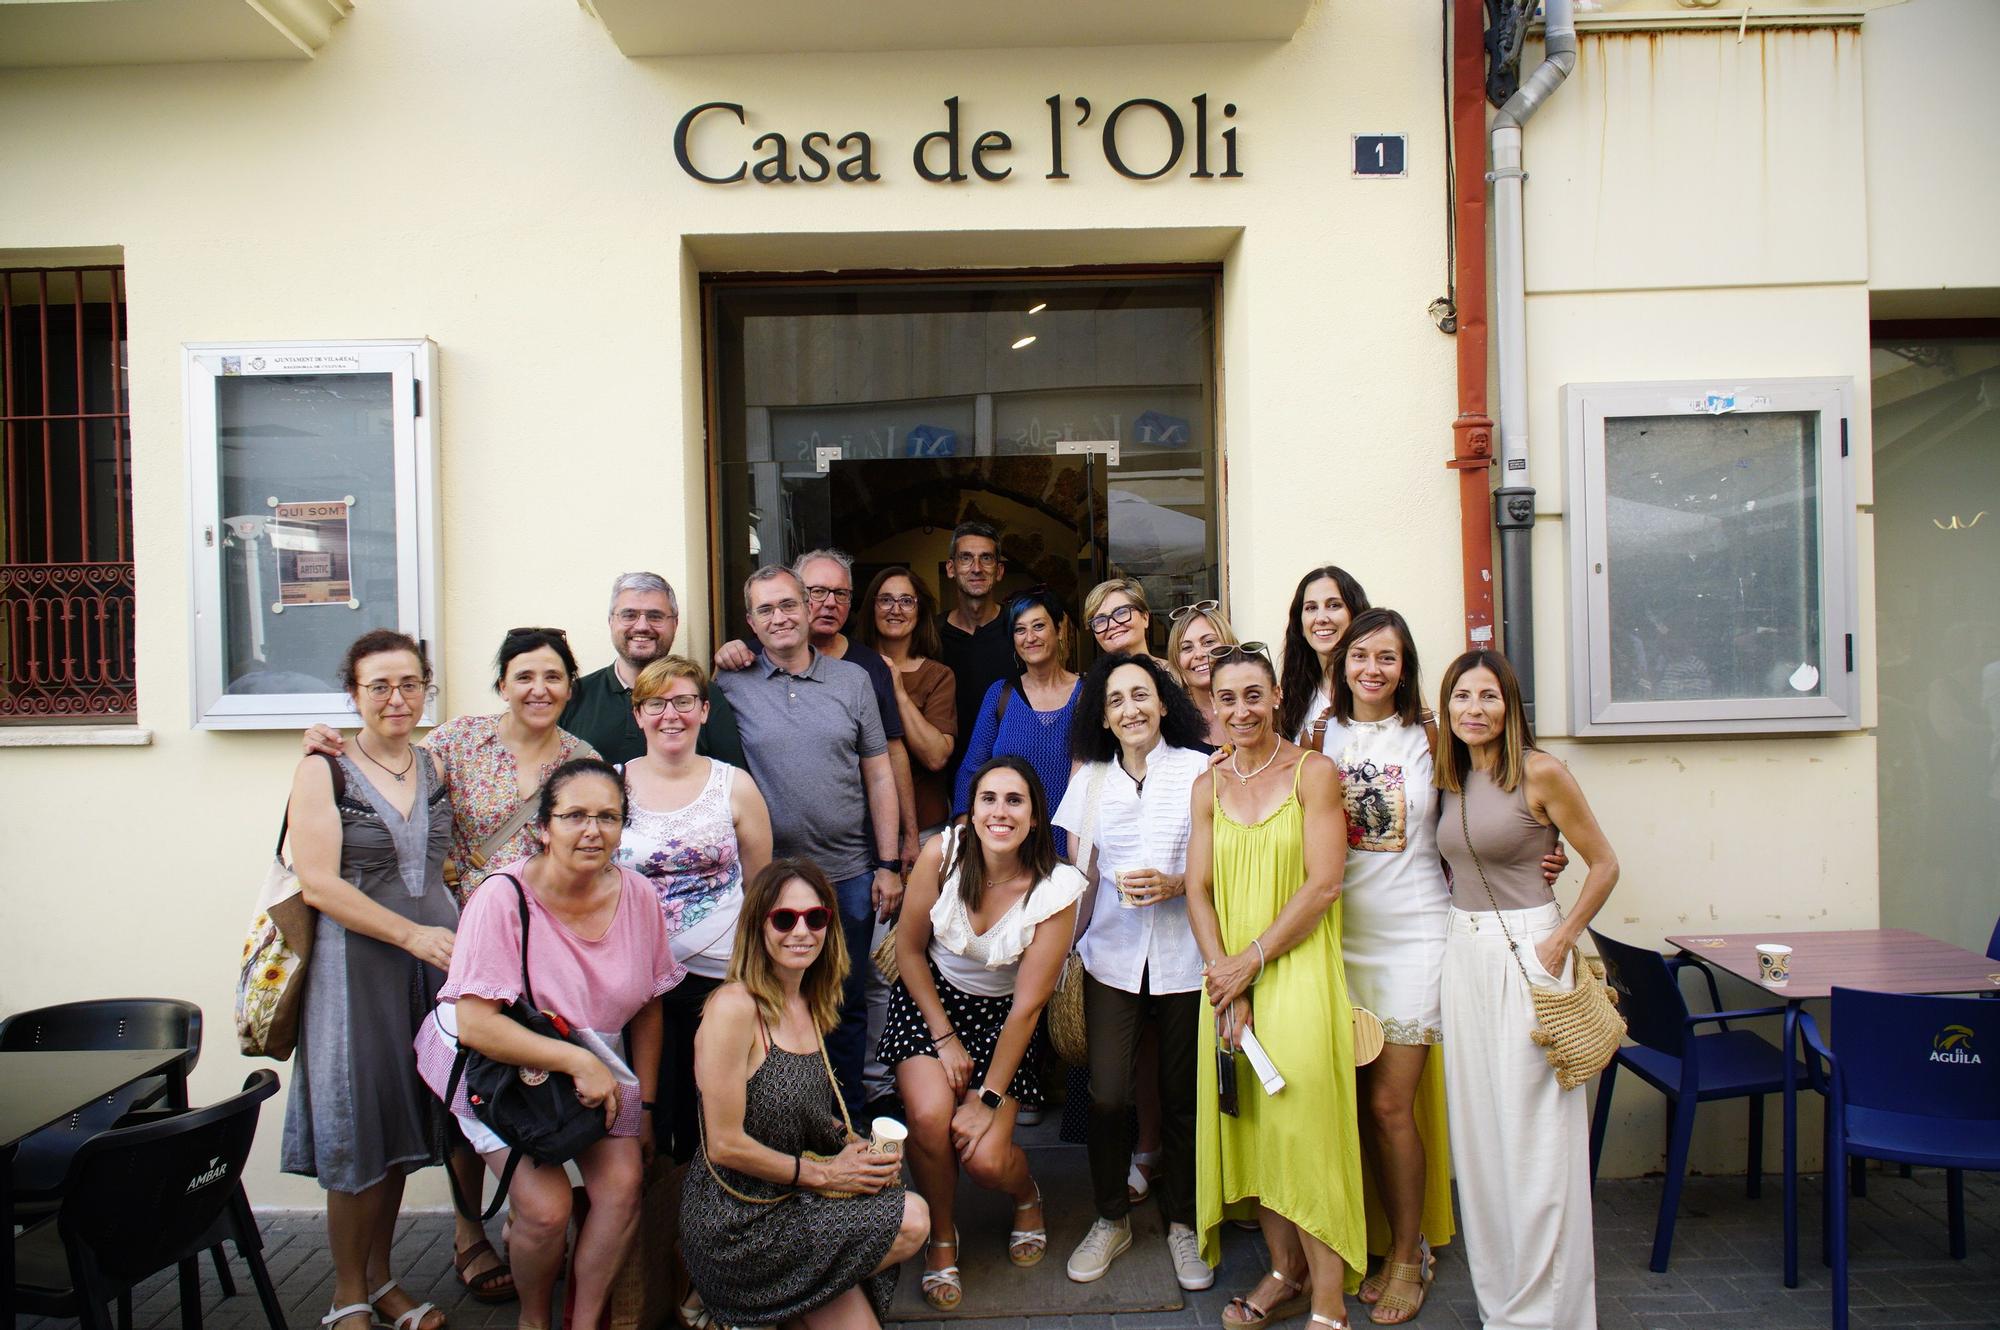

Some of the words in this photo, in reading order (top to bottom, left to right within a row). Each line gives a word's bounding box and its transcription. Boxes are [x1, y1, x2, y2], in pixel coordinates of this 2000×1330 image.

[673, 101, 881, 184] Casa
[913, 95, 1012, 182] de
[1045, 93, 1244, 180] l'Oli
[1375, 142, 1384, 168] 1
[279, 508, 303, 518] QUI
[186, 1163, 228, 1192] AMBAR
